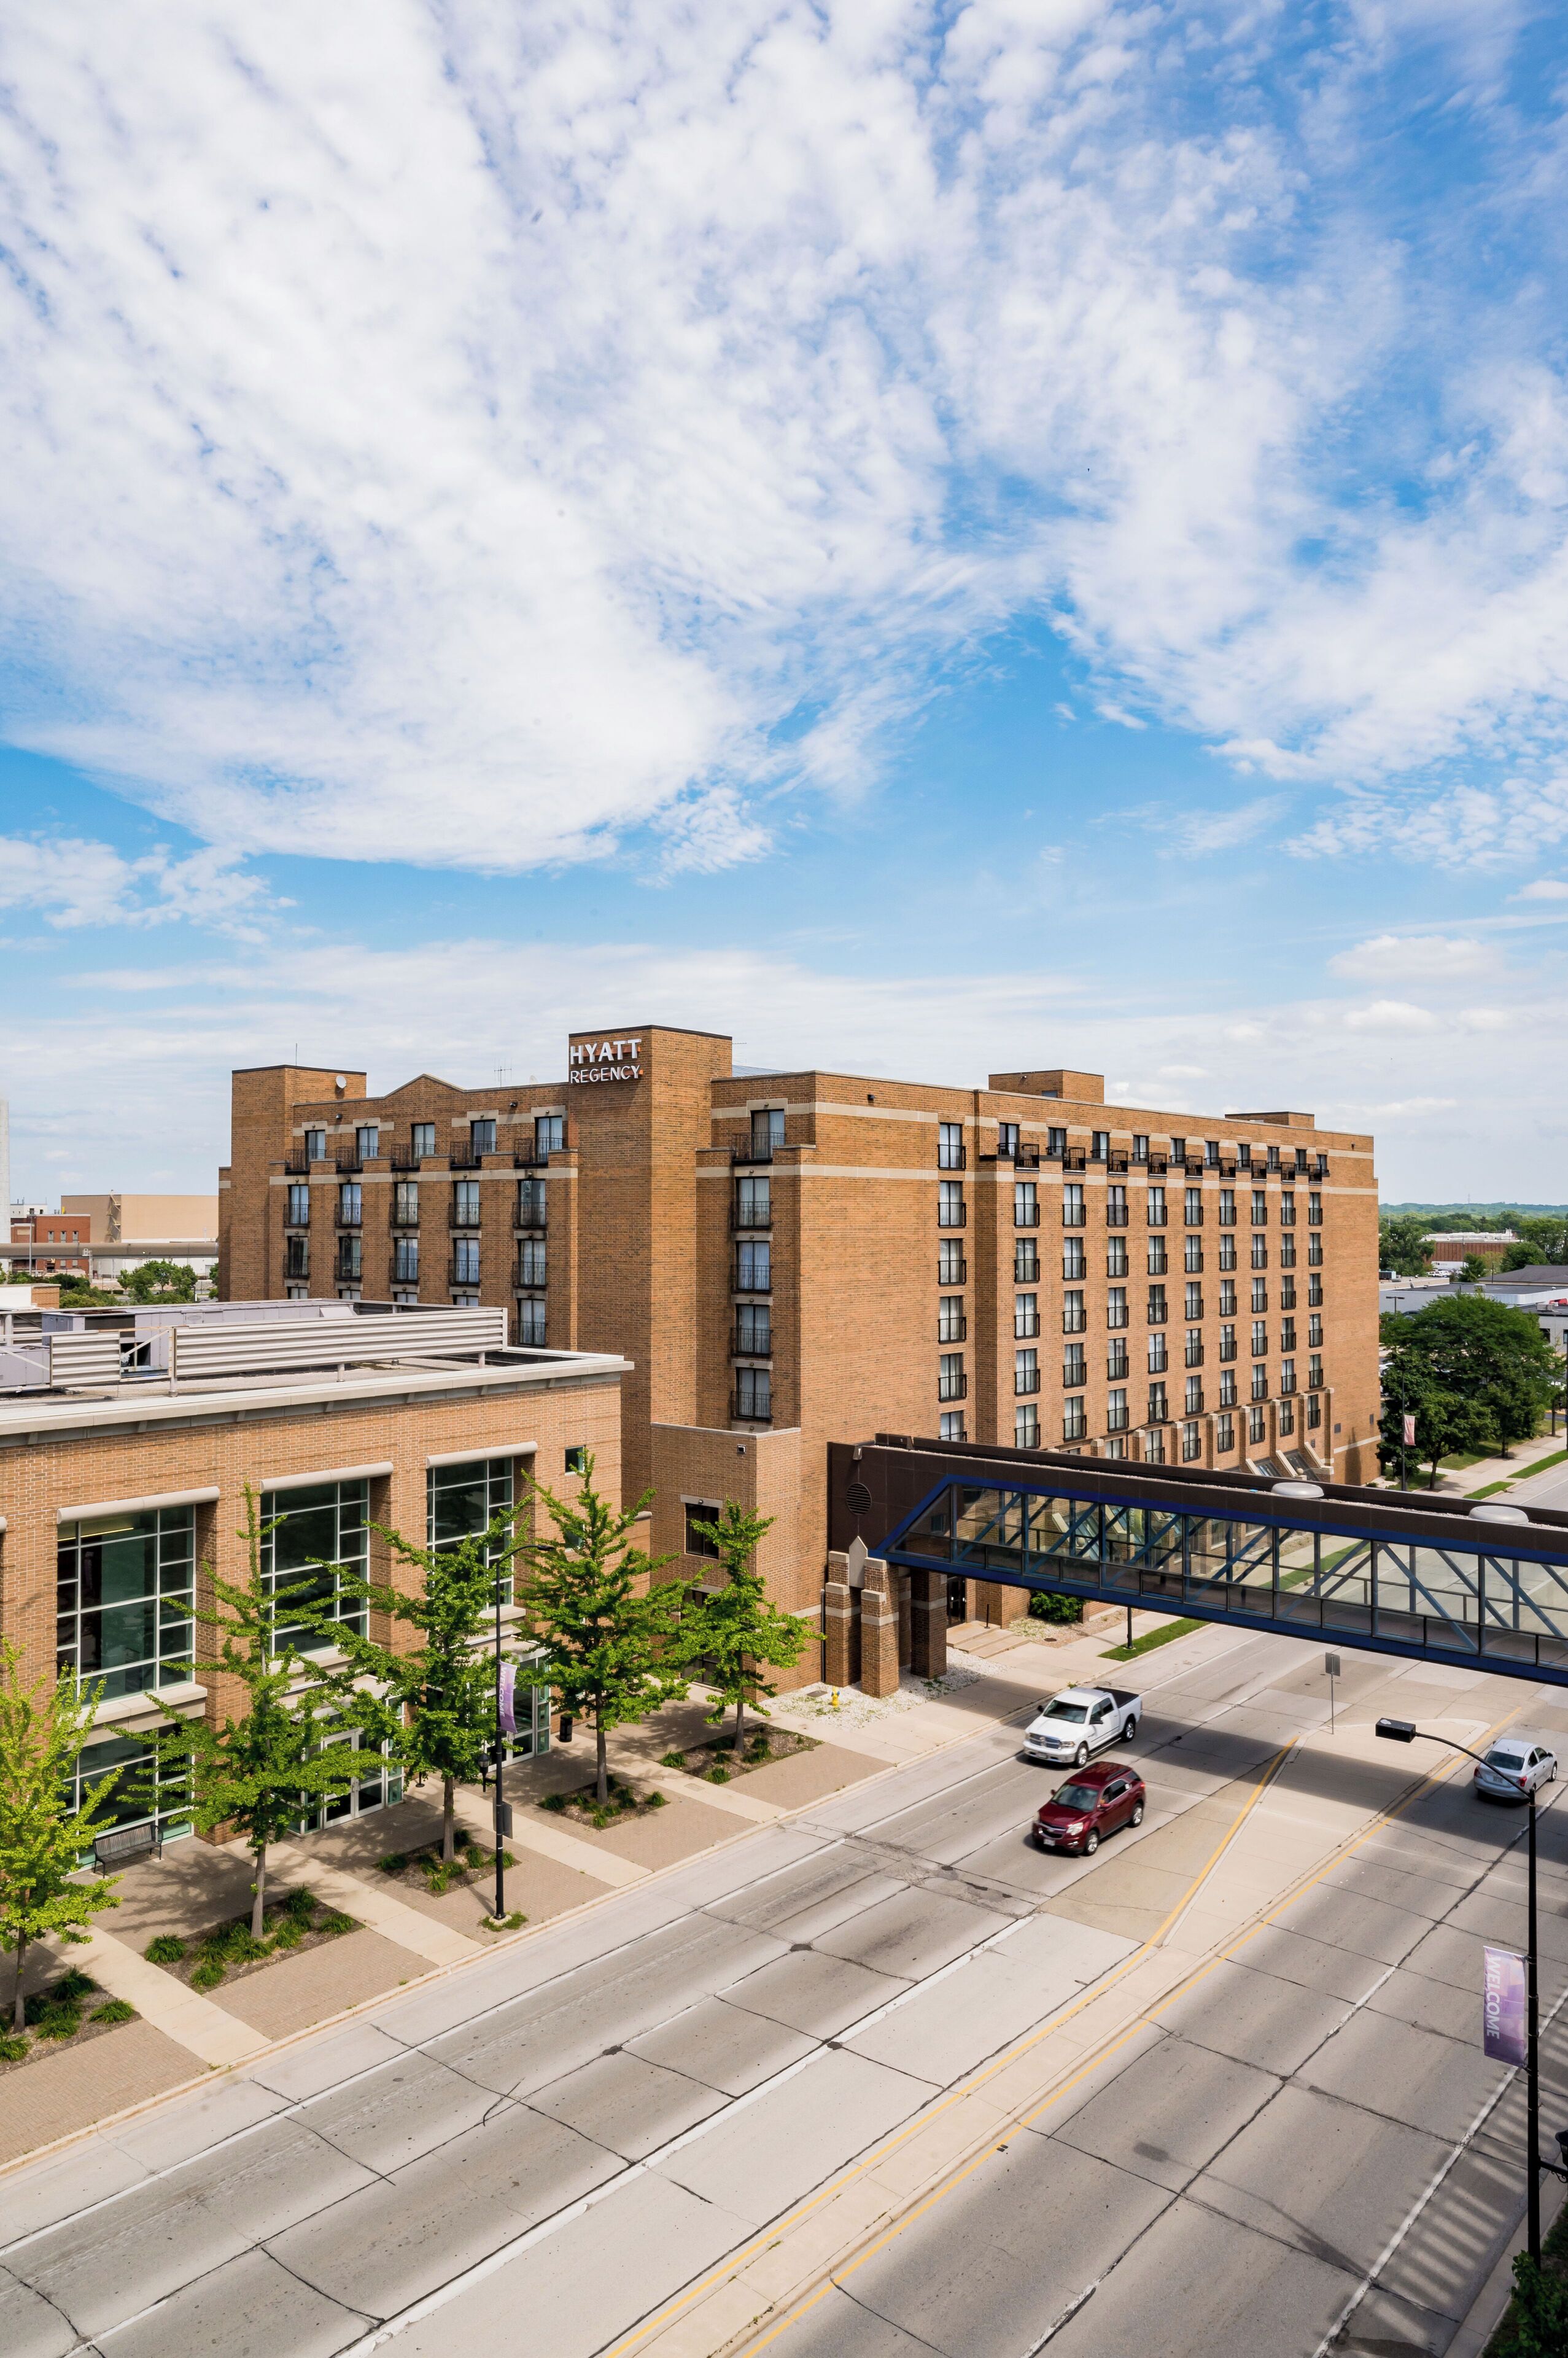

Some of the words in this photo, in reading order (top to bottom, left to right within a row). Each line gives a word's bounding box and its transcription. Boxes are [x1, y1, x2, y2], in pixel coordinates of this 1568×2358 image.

[570, 1038, 642, 1064] HYATT
[570, 1065, 640, 1084] REGENCY
[499, 1667, 507, 1717] WELCOME
[1486, 1956, 1501, 2039] WELCOME
